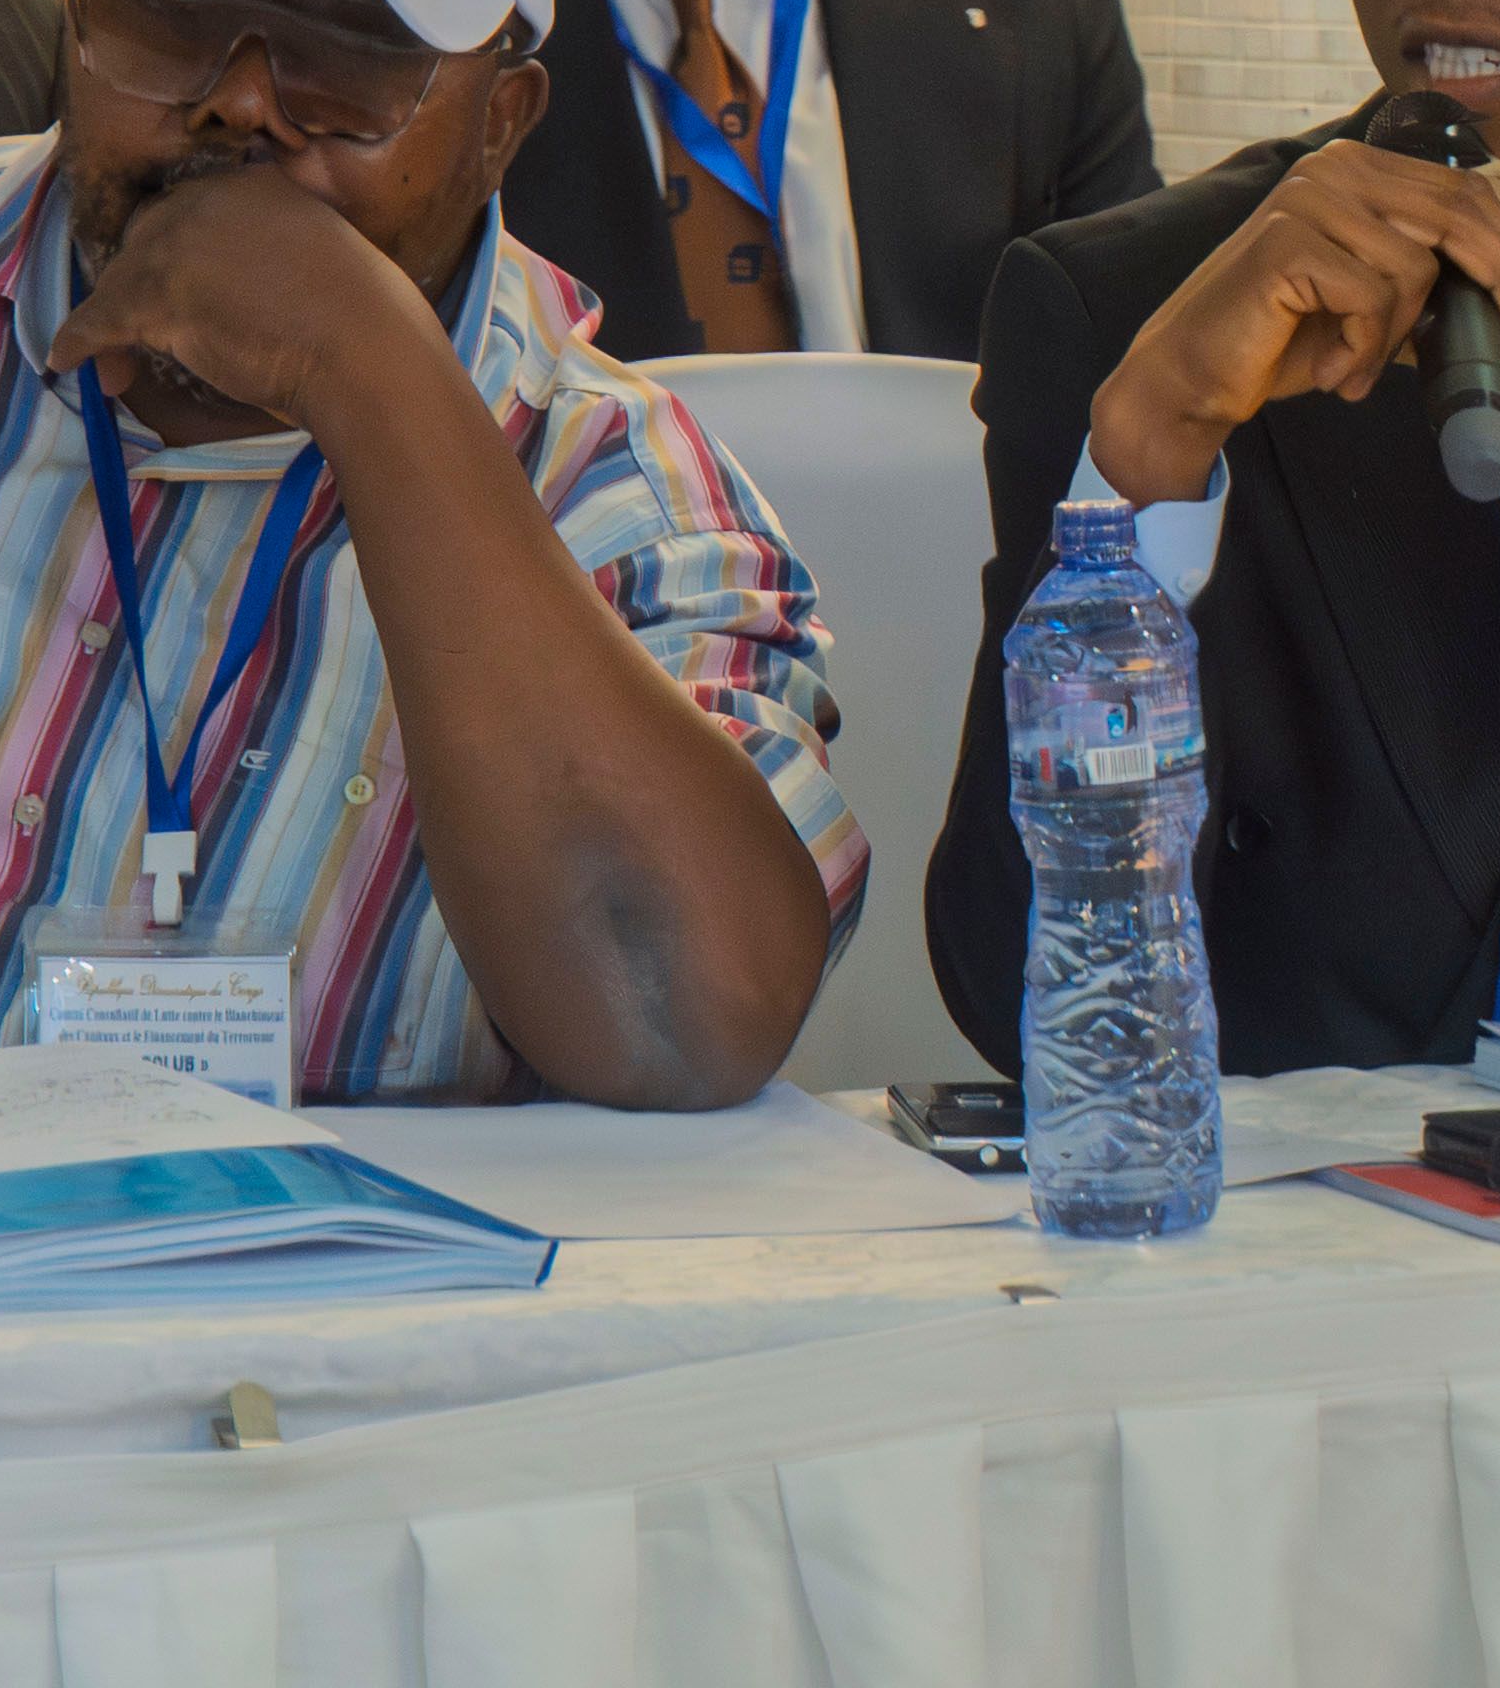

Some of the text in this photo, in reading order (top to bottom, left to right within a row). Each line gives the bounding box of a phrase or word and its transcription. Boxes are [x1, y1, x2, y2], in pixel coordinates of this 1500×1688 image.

[228, 971, 264, 1004] Congo
[143, 1008, 153, 1021] de
[154, 1008, 179, 1021] Lutte
[182, 1009, 213, 1021] contre
[214, 1008, 222, 1021] le
[122, 1031, 131, 1042] et
[134, 1030, 142, 1042] le
[143, 1030, 205, 1043] Financement
[221, 1030, 275, 1044] Terrorisme
